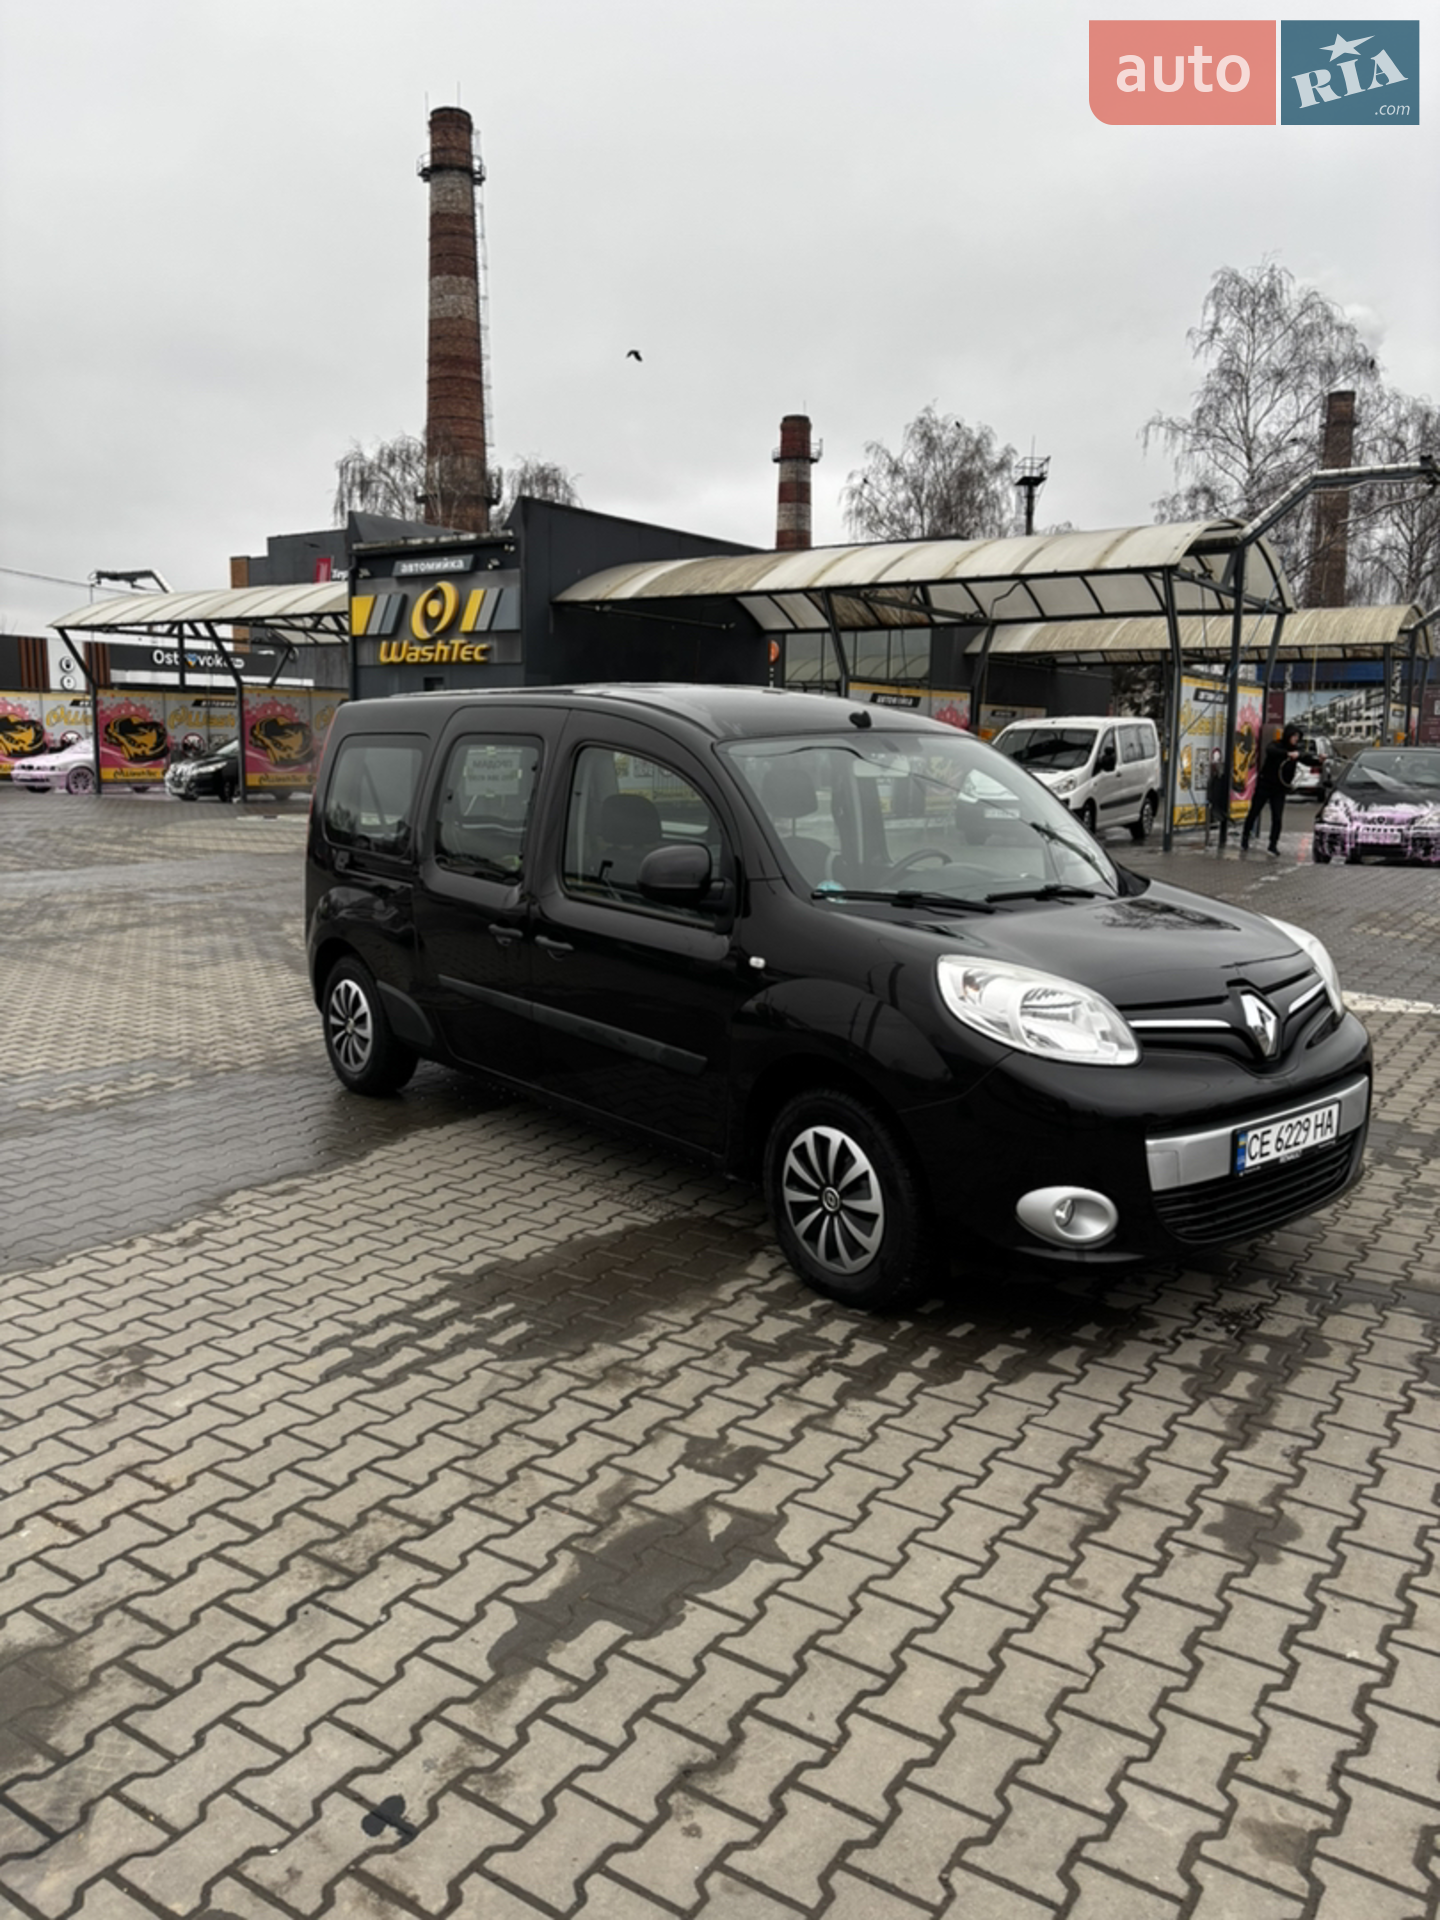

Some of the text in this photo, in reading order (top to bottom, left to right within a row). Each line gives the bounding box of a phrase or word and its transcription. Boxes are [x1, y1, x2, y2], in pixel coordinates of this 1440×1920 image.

[400, 558, 464, 574] автомийка
[379, 638, 490, 664] WashTec
[1248, 1129, 1272, 1161] CE
[1274, 1117, 1310, 1152] 6229
[1313, 1109, 1335, 1141] HA
